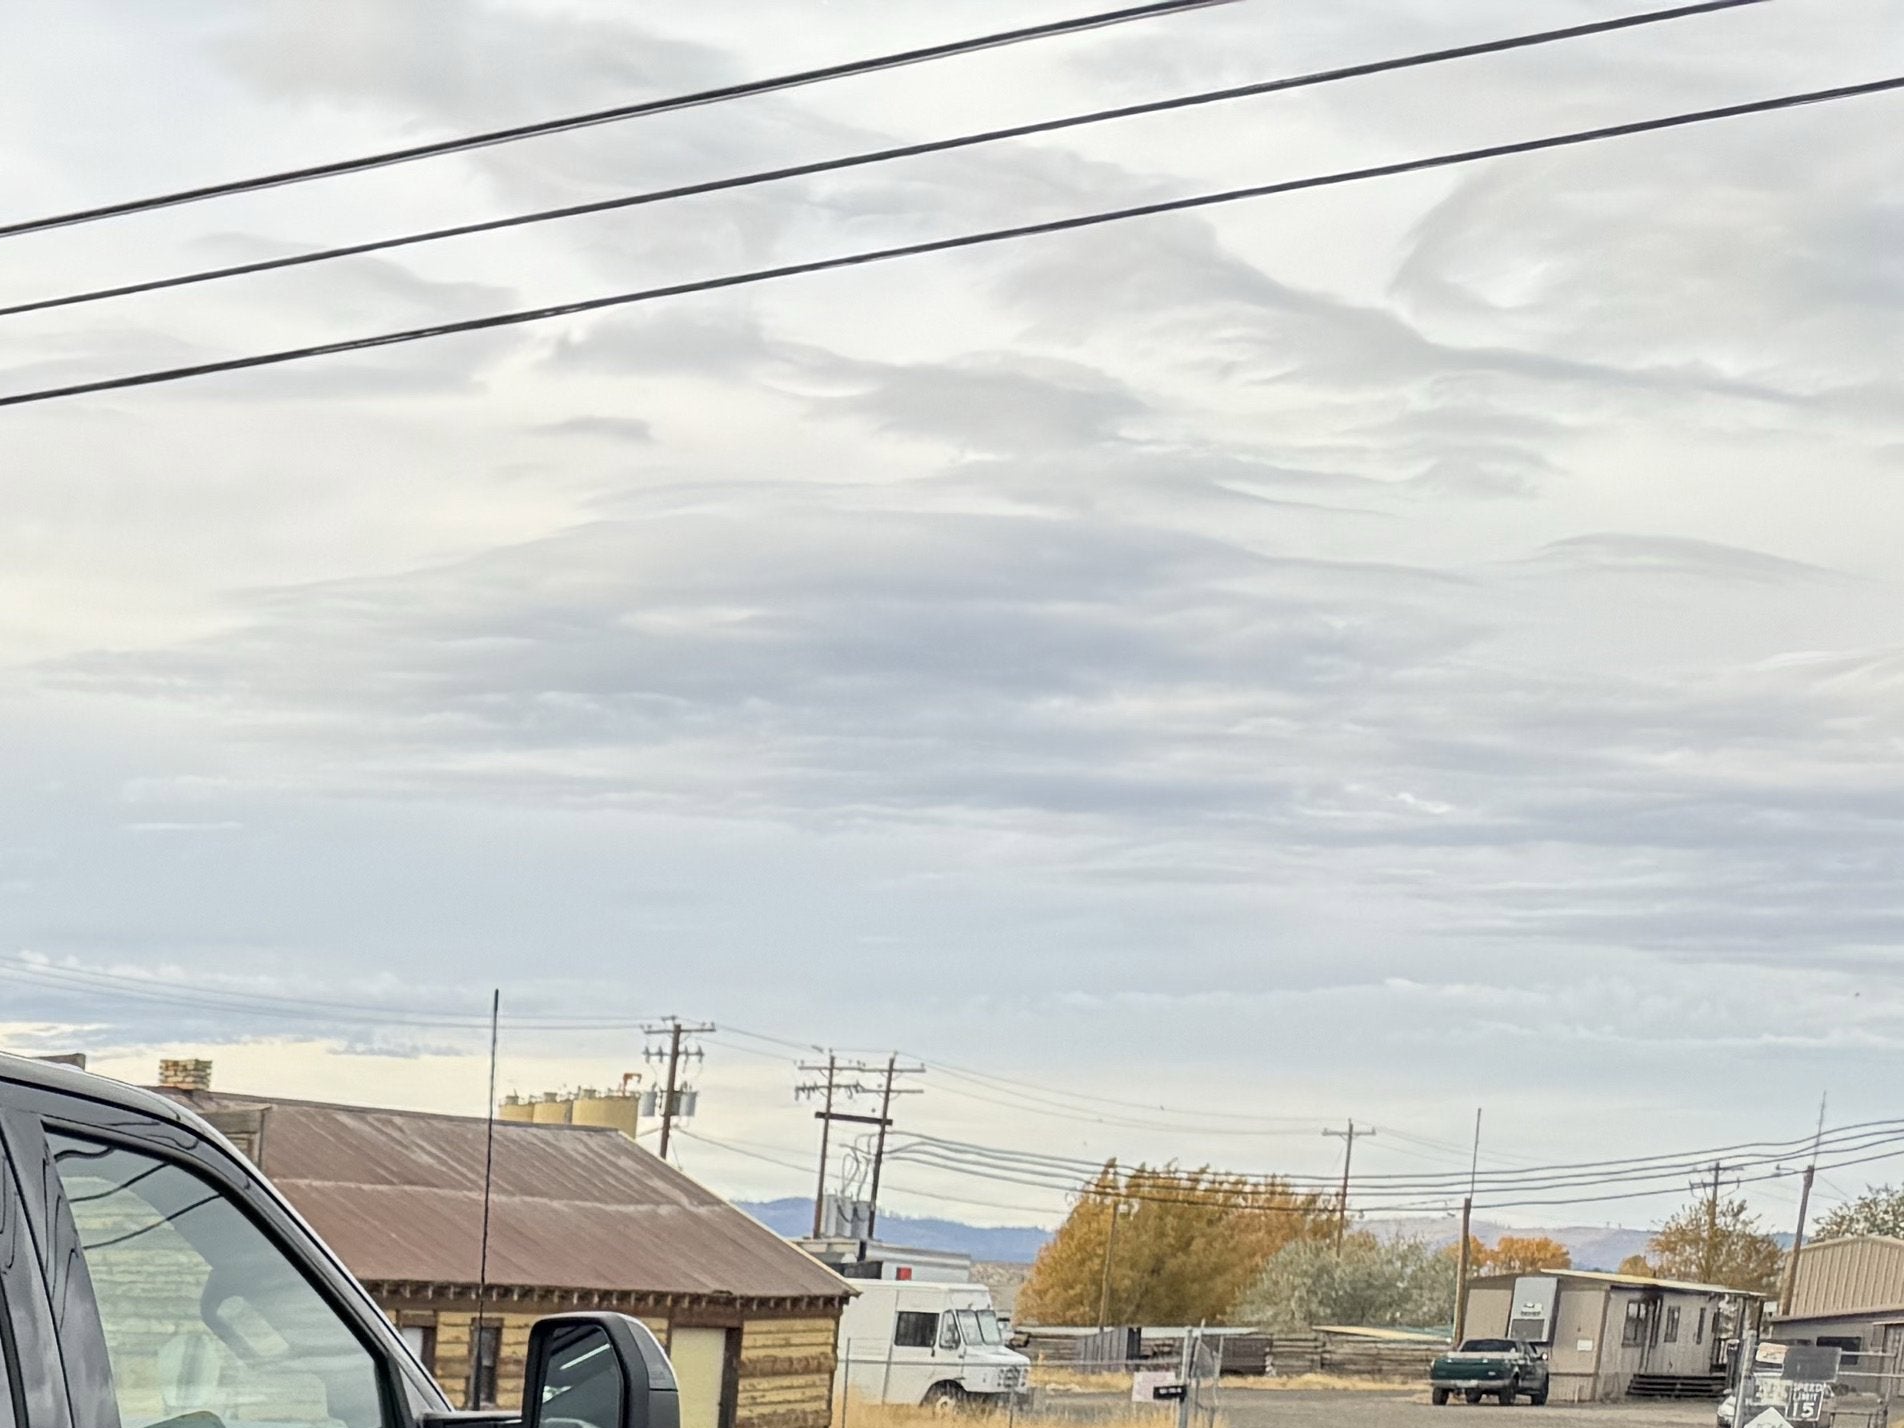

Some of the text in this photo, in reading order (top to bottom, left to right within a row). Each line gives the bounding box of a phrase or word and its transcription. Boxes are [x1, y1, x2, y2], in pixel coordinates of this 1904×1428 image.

[1793, 1382, 1823, 1392] SPEED
[1793, 1392, 1818, 1401] LIMIT
[1793, 1402, 1815, 1418] 15
